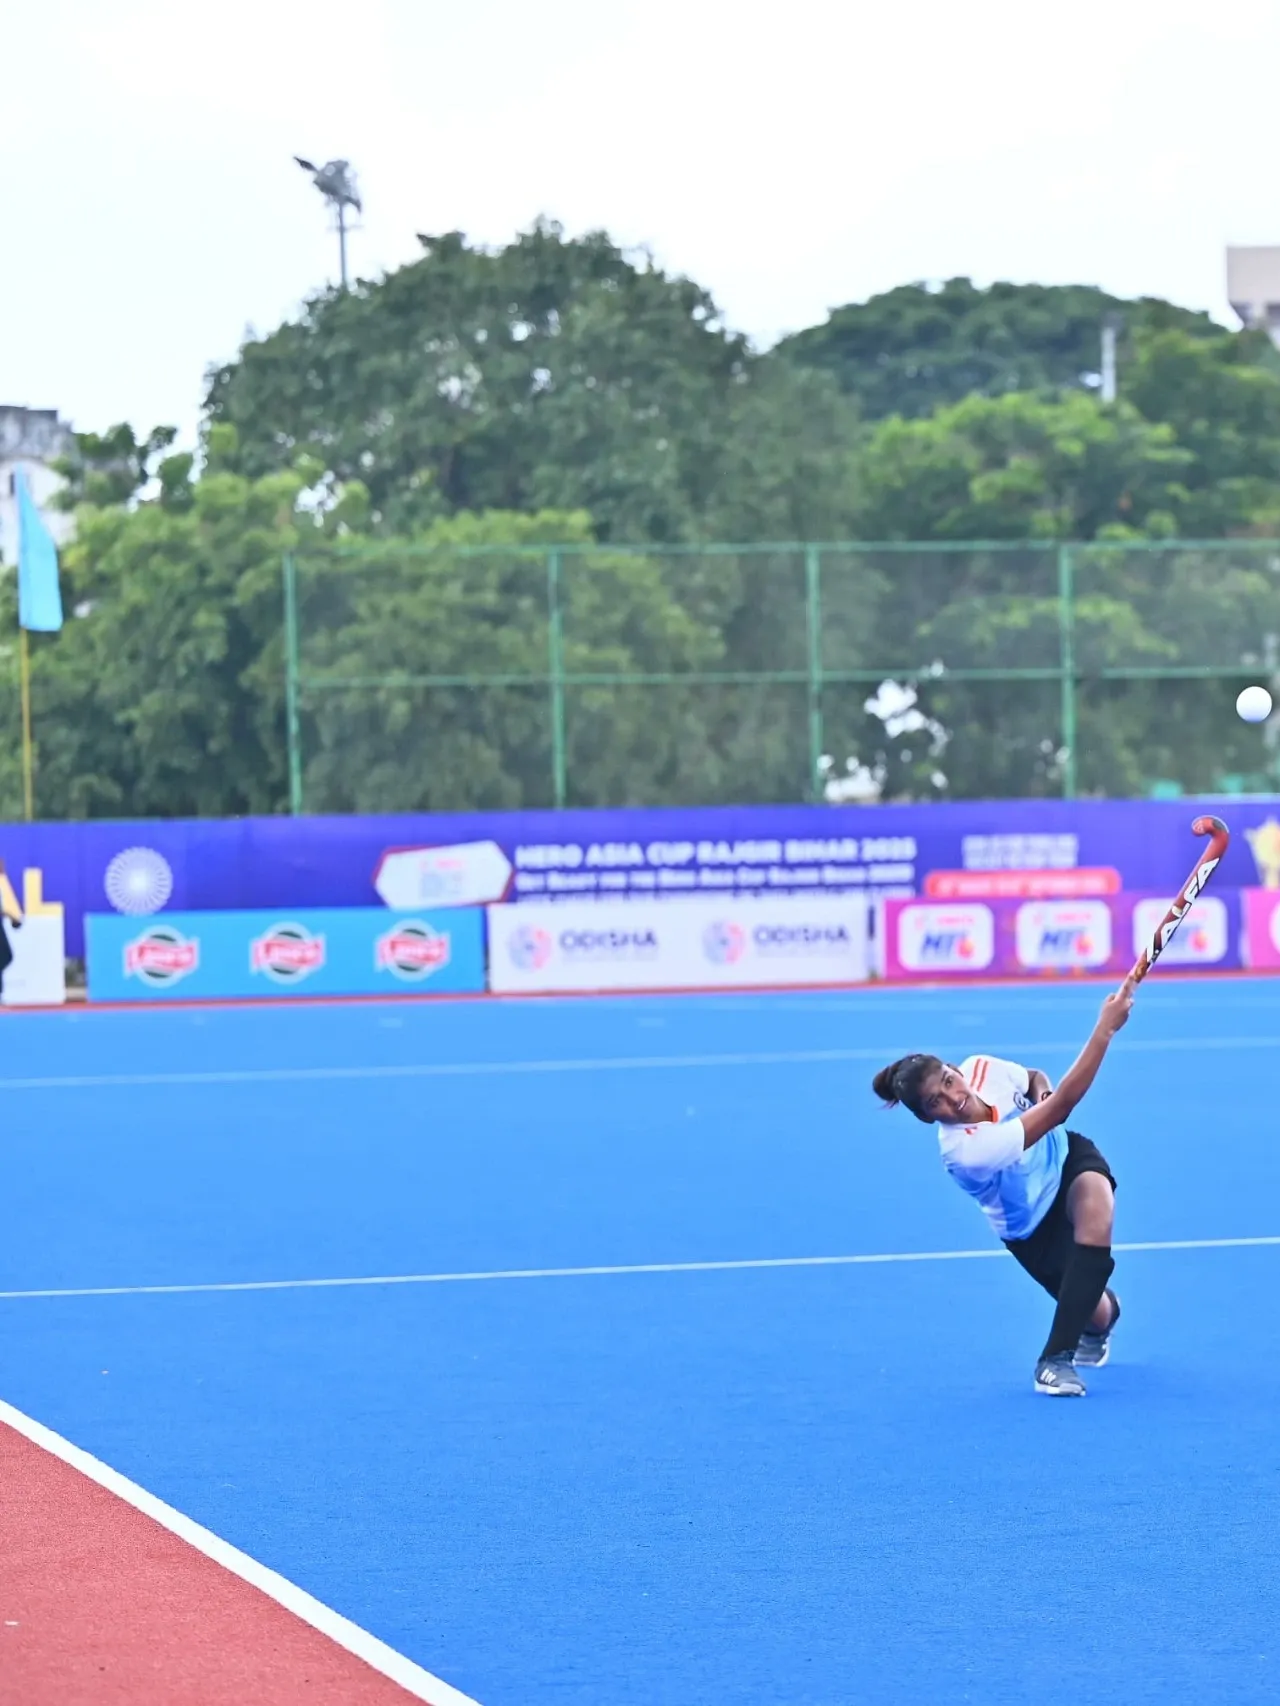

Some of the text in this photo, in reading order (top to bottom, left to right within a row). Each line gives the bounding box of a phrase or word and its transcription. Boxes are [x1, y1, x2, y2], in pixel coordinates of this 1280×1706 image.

[515, 843, 584, 869] HERO
[585, 842, 645, 867] ASIA
[646, 840, 696, 866] CUP
[560, 928, 658, 950] ODISHA
[753, 923, 849, 945] ODISHA
